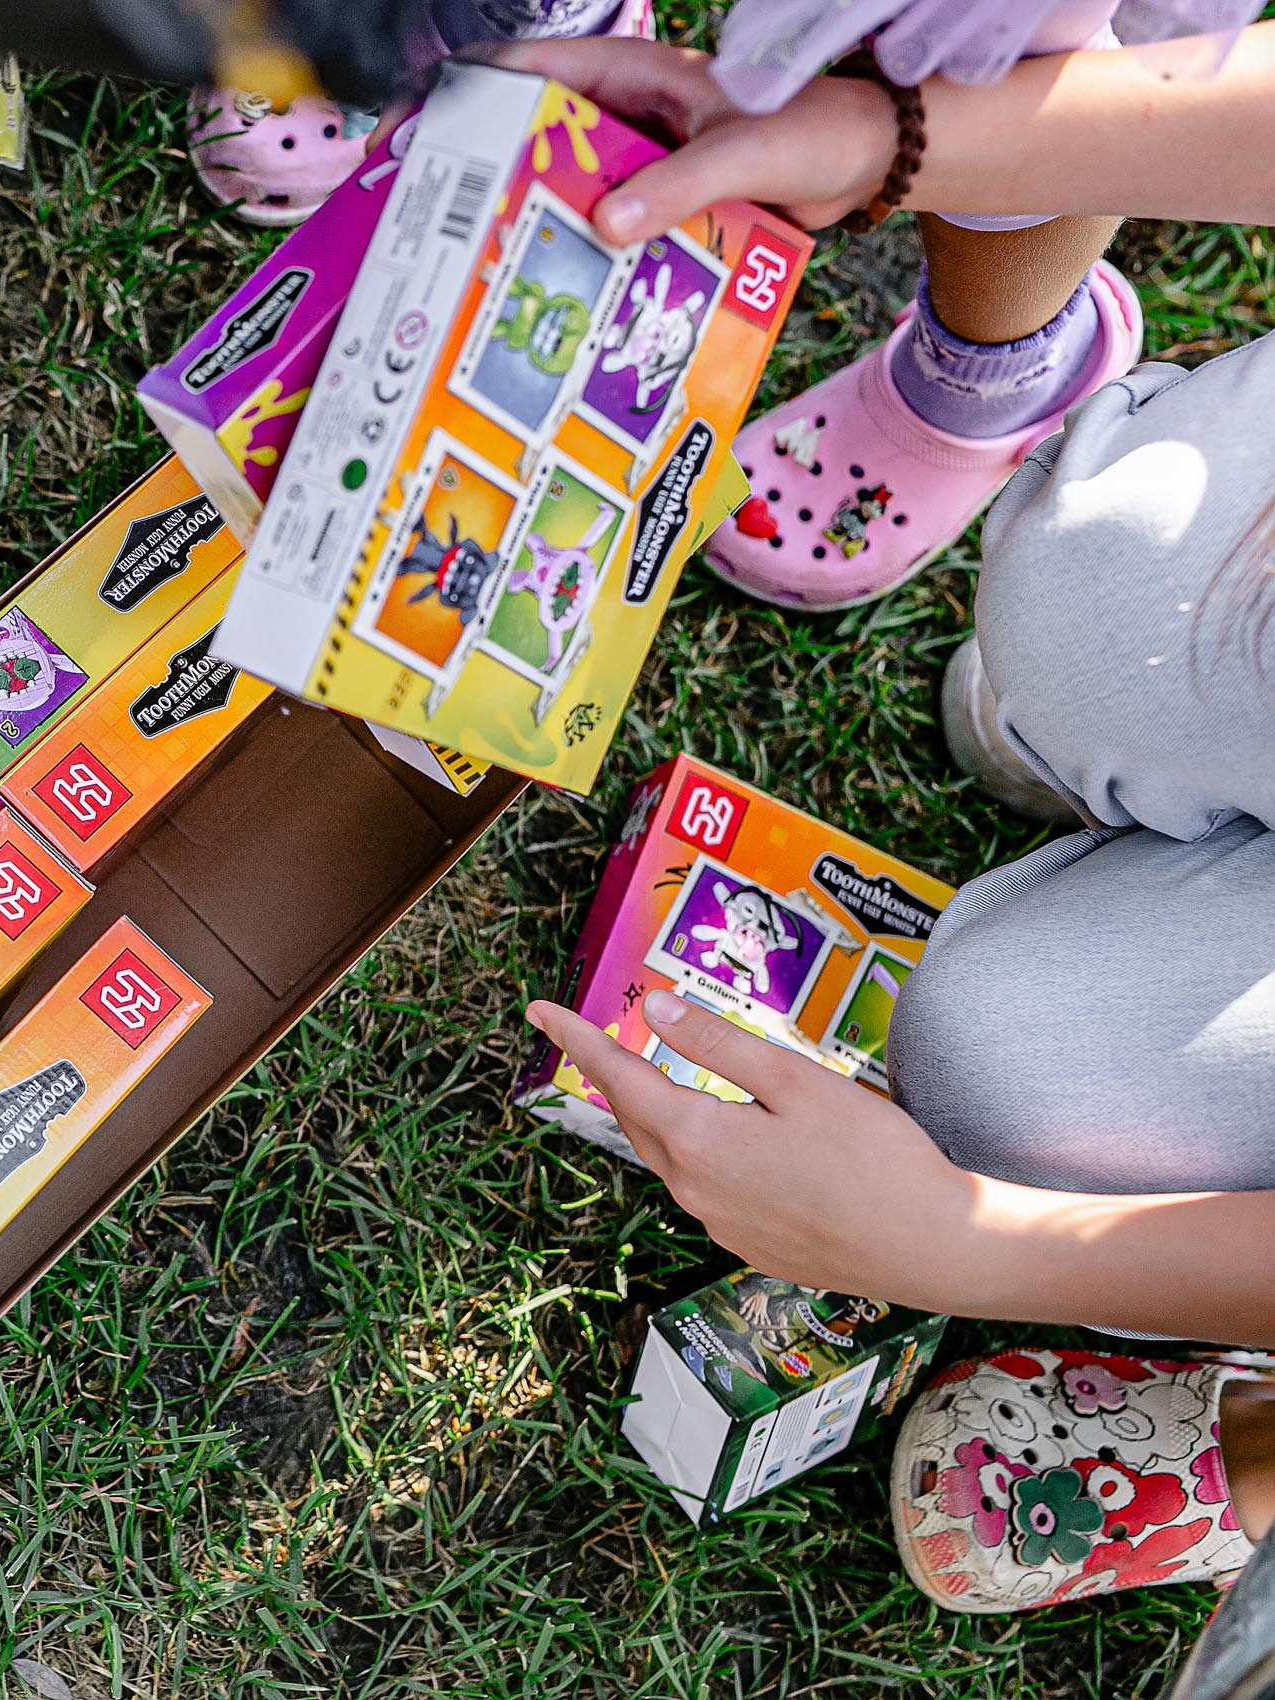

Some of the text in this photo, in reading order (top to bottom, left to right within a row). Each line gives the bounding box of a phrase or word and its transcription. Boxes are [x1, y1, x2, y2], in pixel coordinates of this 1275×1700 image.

[116, 508, 187, 573] FUNNY UGLY MONSTER
[136, 655, 220, 727] TOOTHMON
[170, 697, 196, 721] FUNNY
[192, 683, 212, 701] UGLY
[697, 976, 739, 1004] Gollum
[17, 1080, 42, 1107] FUNNY
[0, 1104, 21, 1126] UGLY
